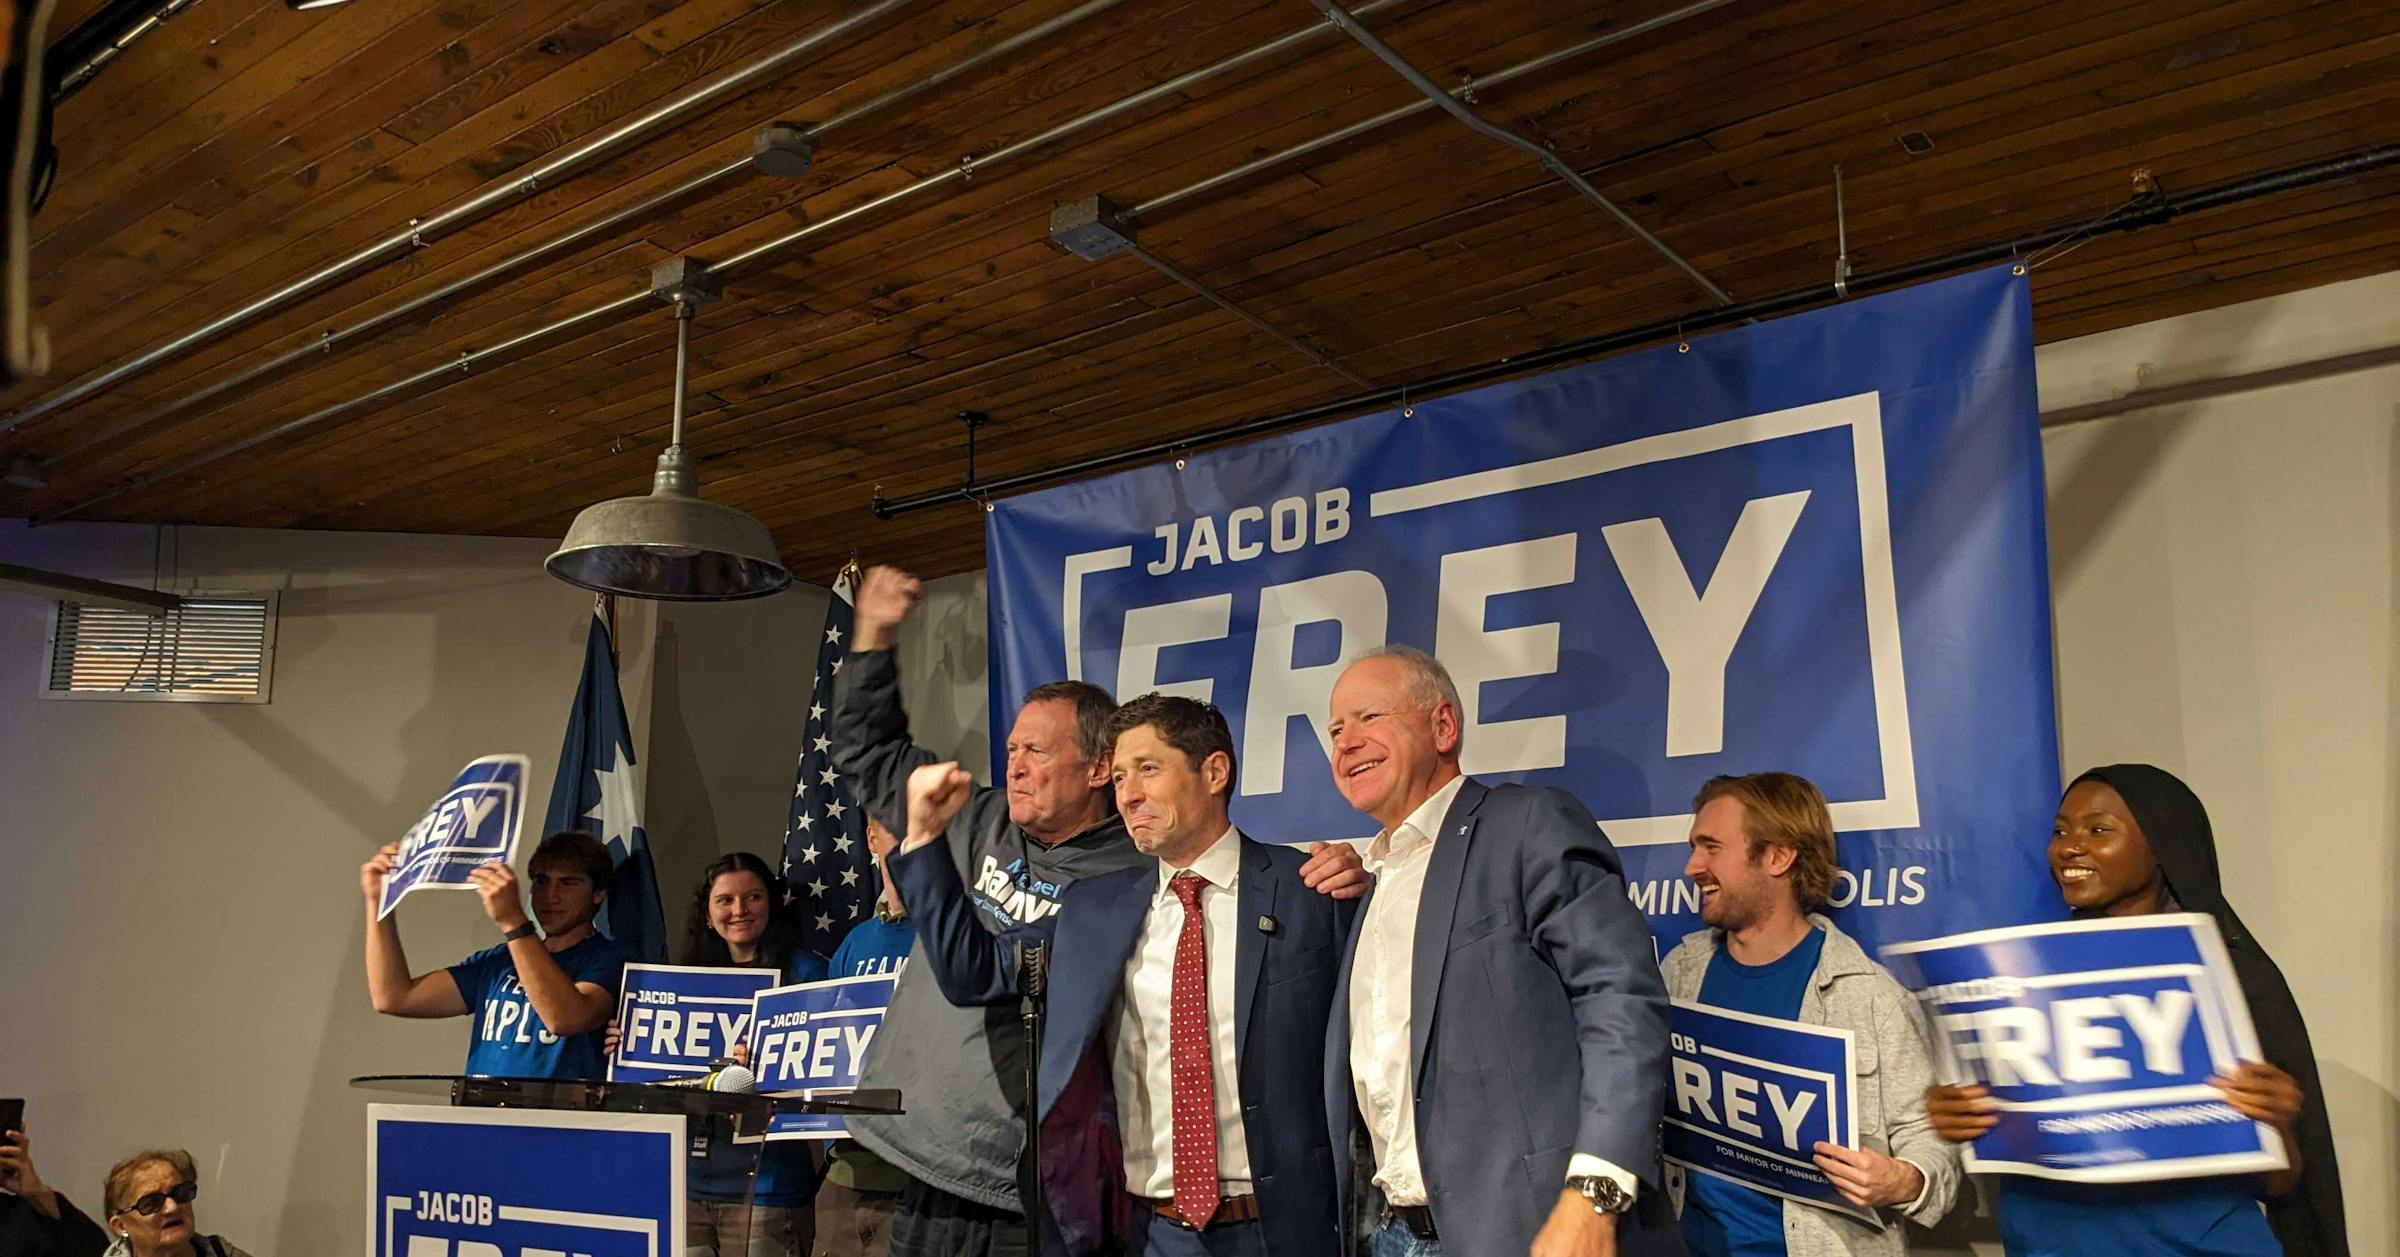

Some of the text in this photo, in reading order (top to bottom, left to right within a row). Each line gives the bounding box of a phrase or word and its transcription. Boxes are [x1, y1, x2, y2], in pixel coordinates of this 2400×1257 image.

[1147, 486, 1351, 577] JACOB
[1116, 489, 1812, 798] FREY
[1627, 865, 1927, 916] MINOLIS
[501, 974, 528, 996] TE
[636, 989, 676, 1005] JACOB
[625, 1007, 751, 1058] FREY
[770, 1011, 808, 1028] JACOB
[1935, 988, 2196, 1087] FREY
[756, 1024, 878, 1083] FREY
[1672, 1055, 1817, 1151] REY
[1715, 1145, 1735, 1159] FOR
[1736, 1152, 1769, 1169] MAYOR
[1770, 1163, 1784, 1172] OF
[416, 1190, 494, 1227] JACOB
